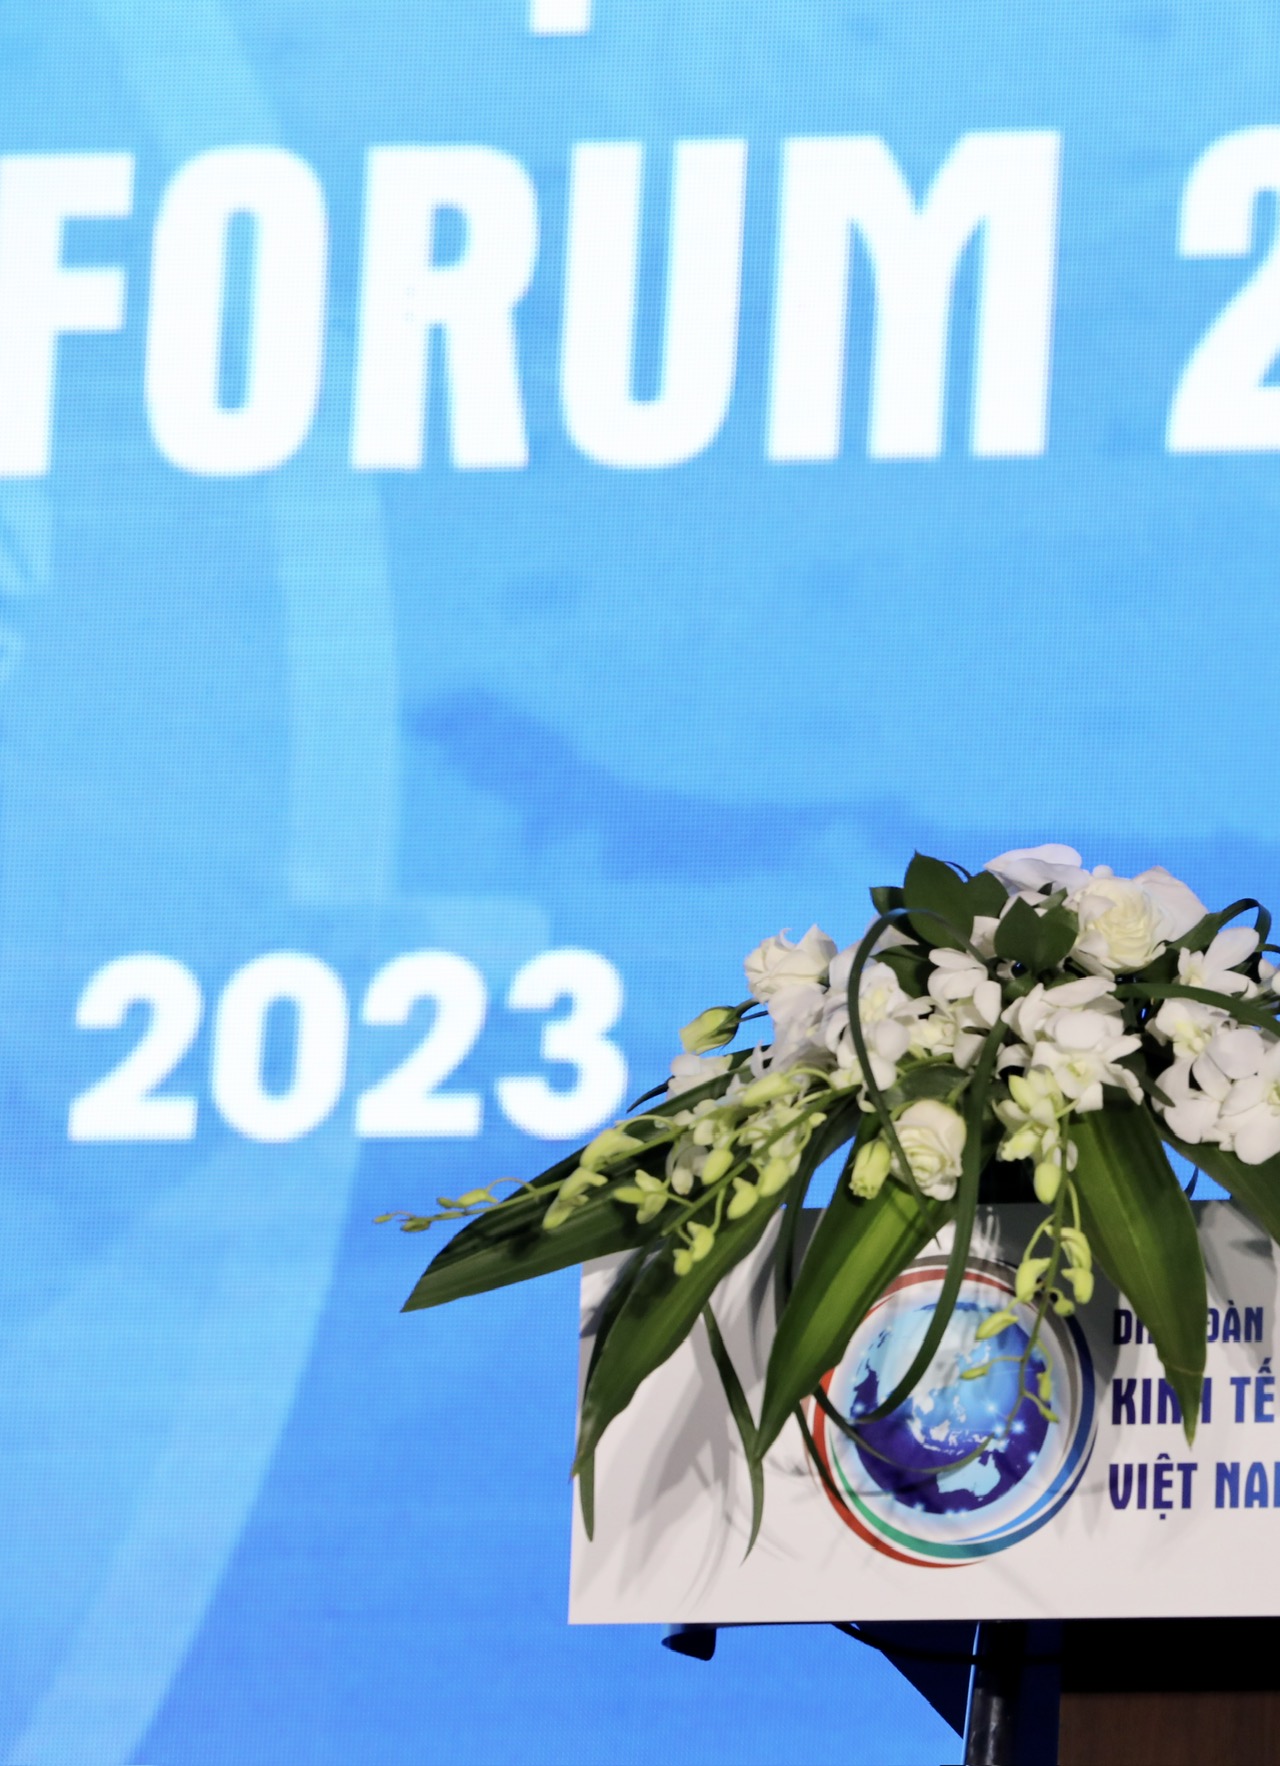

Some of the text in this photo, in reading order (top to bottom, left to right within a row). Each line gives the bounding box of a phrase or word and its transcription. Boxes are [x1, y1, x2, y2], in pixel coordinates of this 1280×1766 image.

[0, 130, 1062, 478] FORUM
[67, 948, 627, 1142] 2023
[1230, 1357, 1275, 1423] TẾ
[1108, 1453, 1198, 1520] VIỆT
